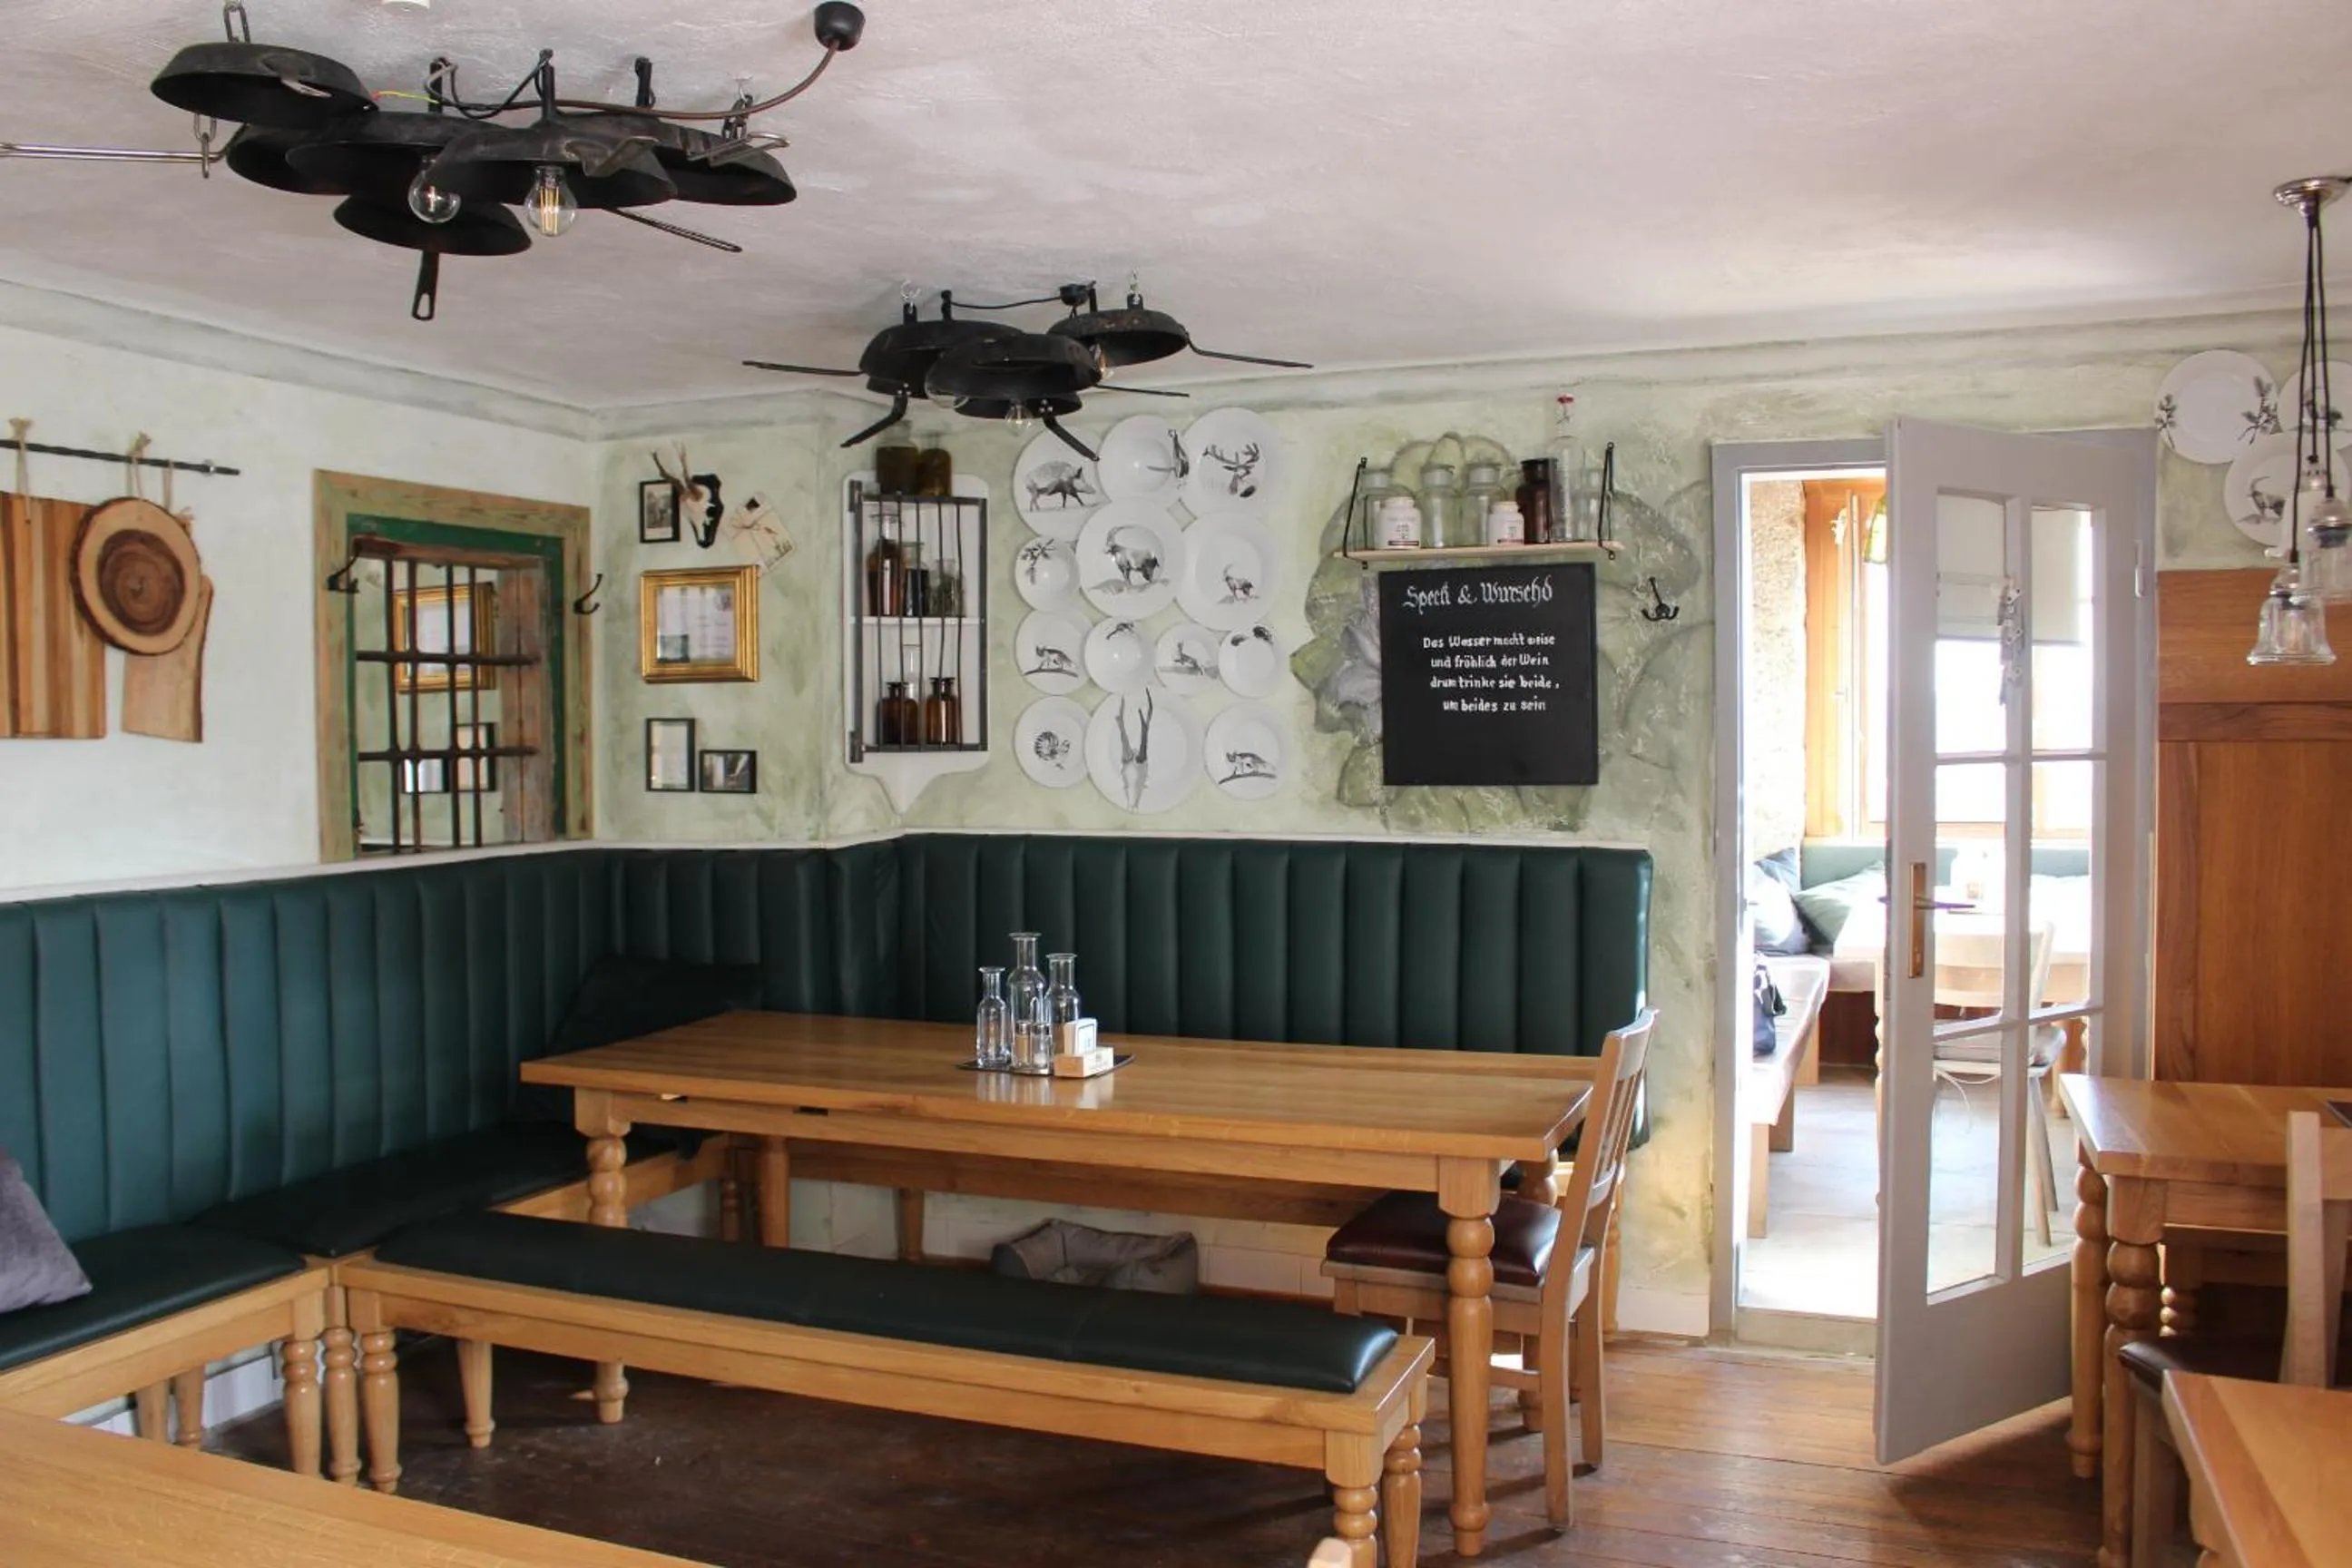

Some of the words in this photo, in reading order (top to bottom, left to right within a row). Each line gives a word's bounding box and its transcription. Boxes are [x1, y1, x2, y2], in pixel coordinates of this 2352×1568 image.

[1403, 581, 1451, 615] Speck
[1457, 584, 1477, 604] &
[1423, 637, 1445, 649] Das
[1448, 635, 1491, 647] Wasser
[1494, 632, 1524, 645] macht
[1526, 633, 1555, 645] weise
[1430, 655, 1452, 668] und
[1455, 654, 1496, 668] fröhlich
[1501, 653, 1517, 667] der
[1519, 652, 1549, 666] Wein
[1430, 675, 1456, 688] drum
[1458, 674, 1496, 689] trinke
[1498, 674, 1515, 689] sie
[1443, 701, 1458, 710] um
[1461, 696, 1498, 711] beides
[1503, 701, 1516, 711] zu
[1521, 695, 1546, 710] sein
